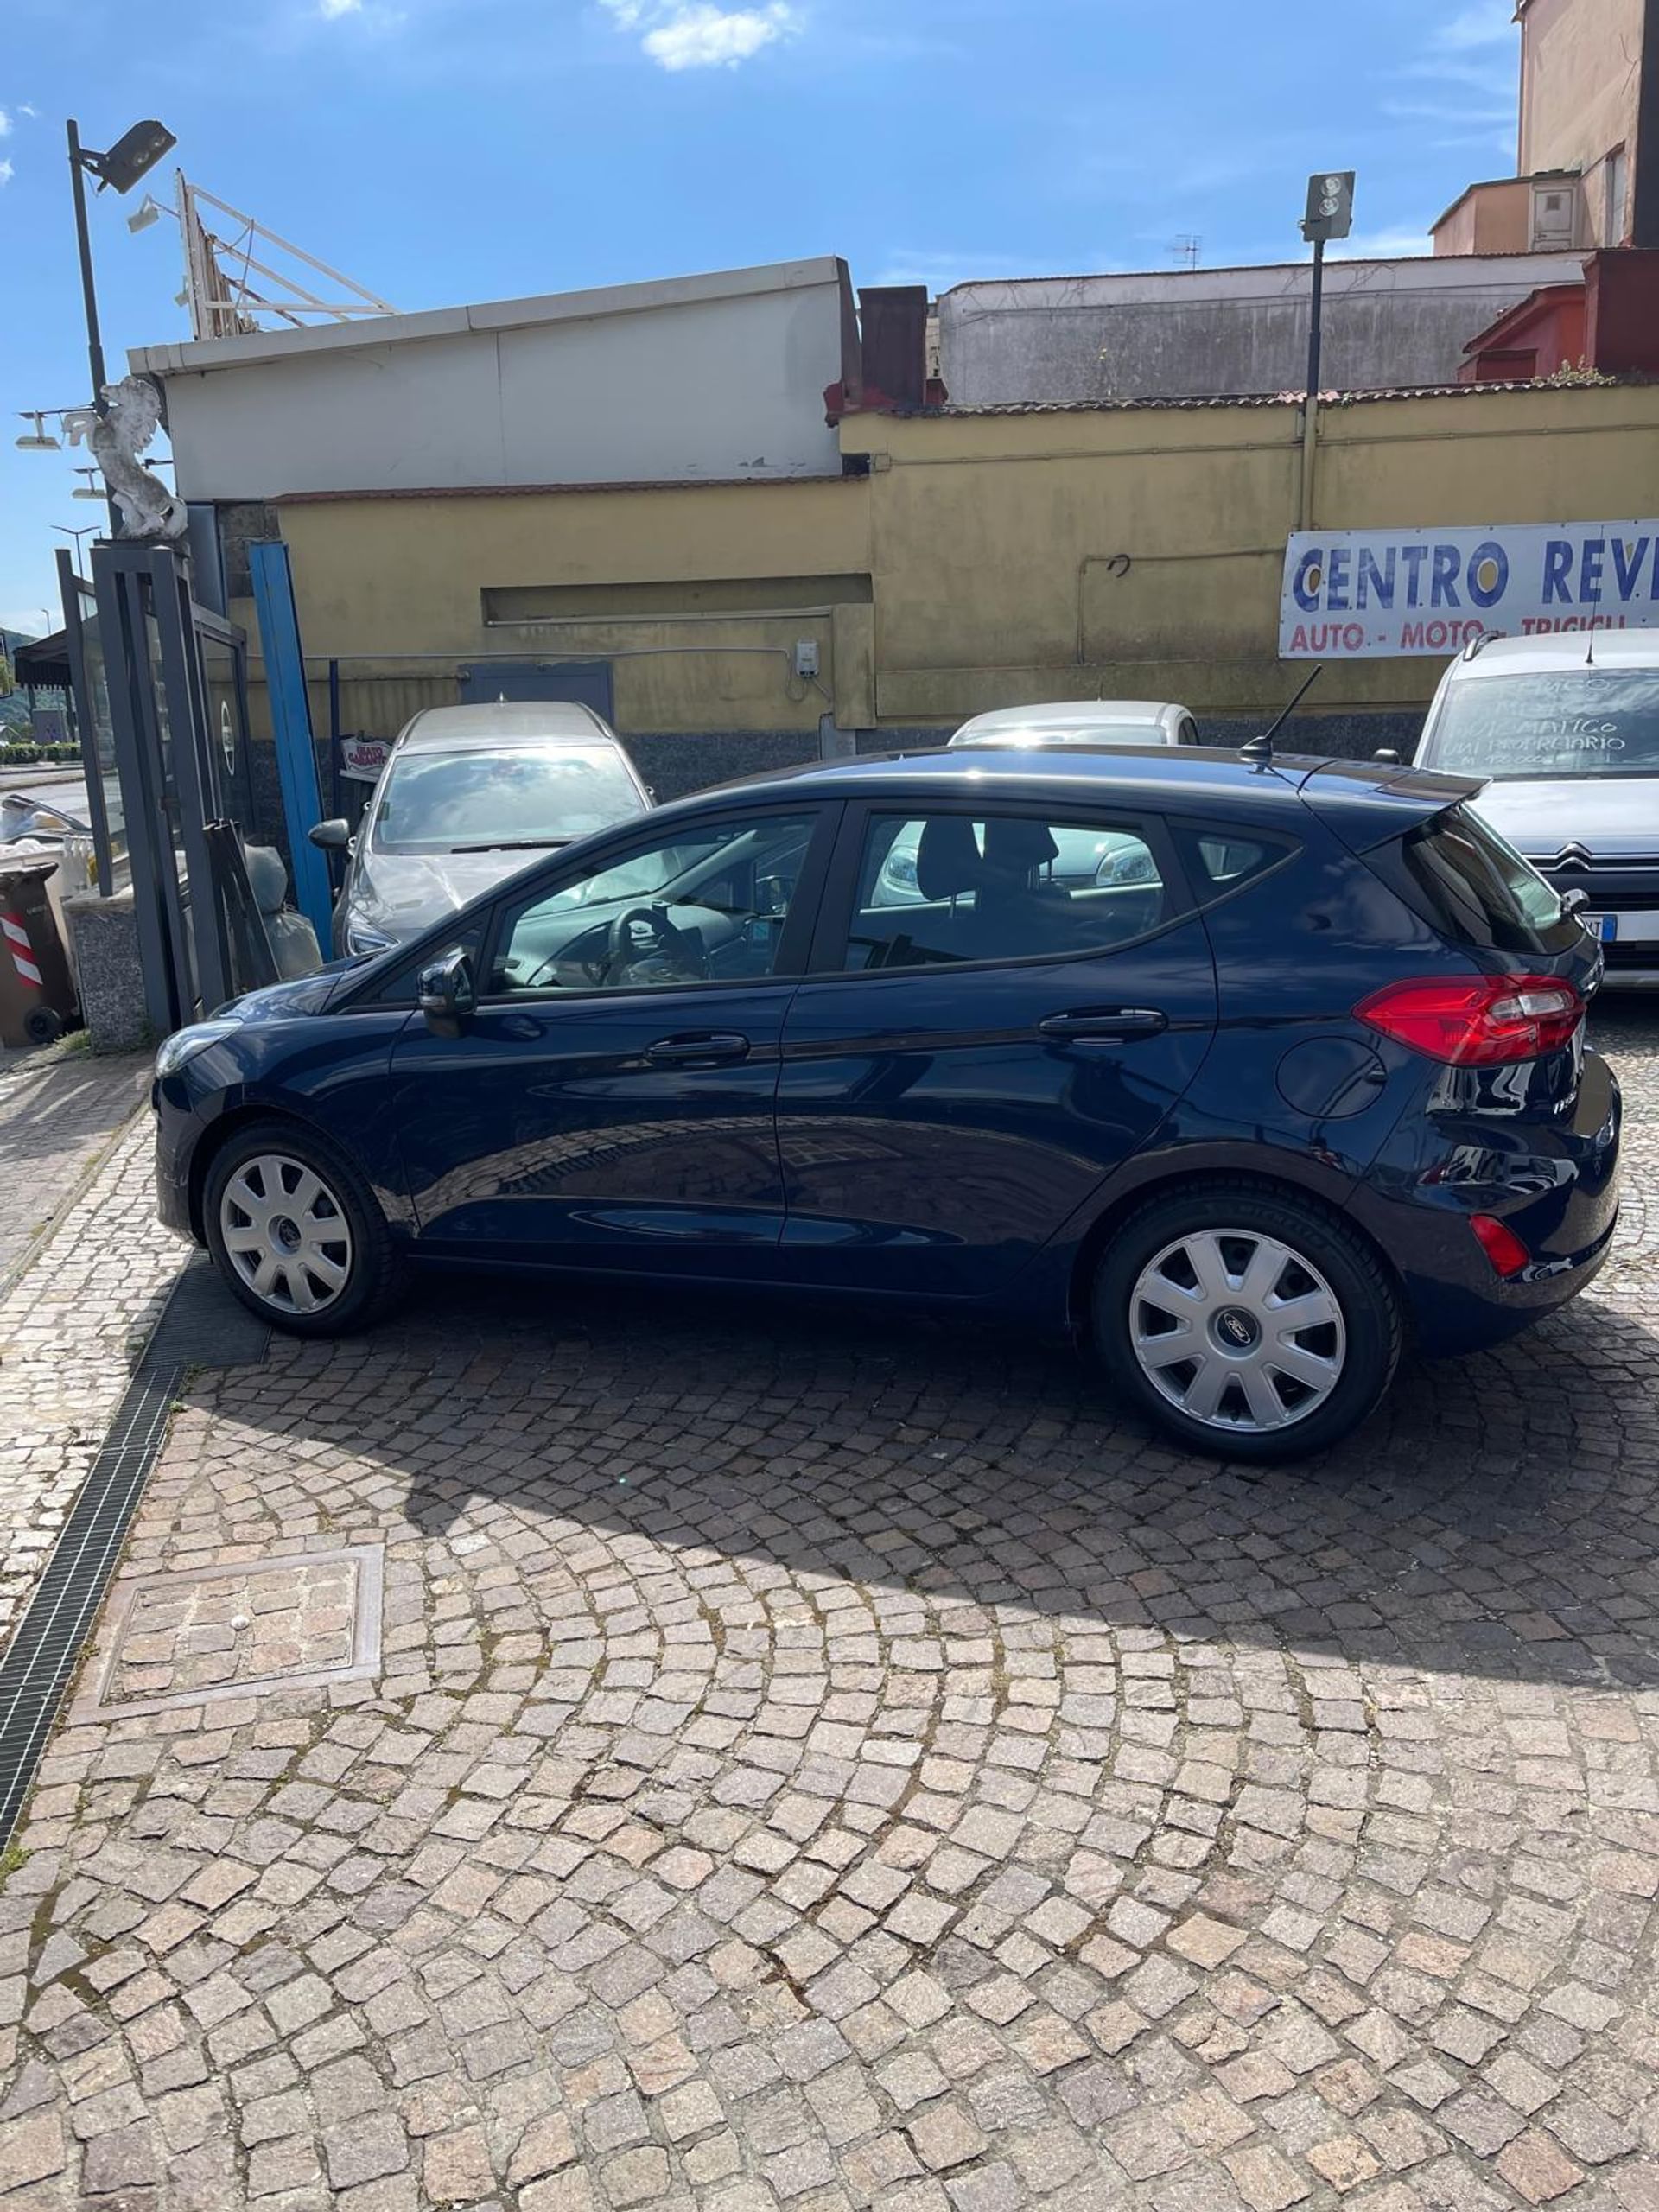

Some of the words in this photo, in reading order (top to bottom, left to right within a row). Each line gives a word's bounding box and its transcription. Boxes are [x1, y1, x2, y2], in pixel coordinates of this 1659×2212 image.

[1294, 542, 1509, 612] CENTRO
[1289, 622, 1363, 652] AUTO
[1400, 620, 1484, 649] MOTO
